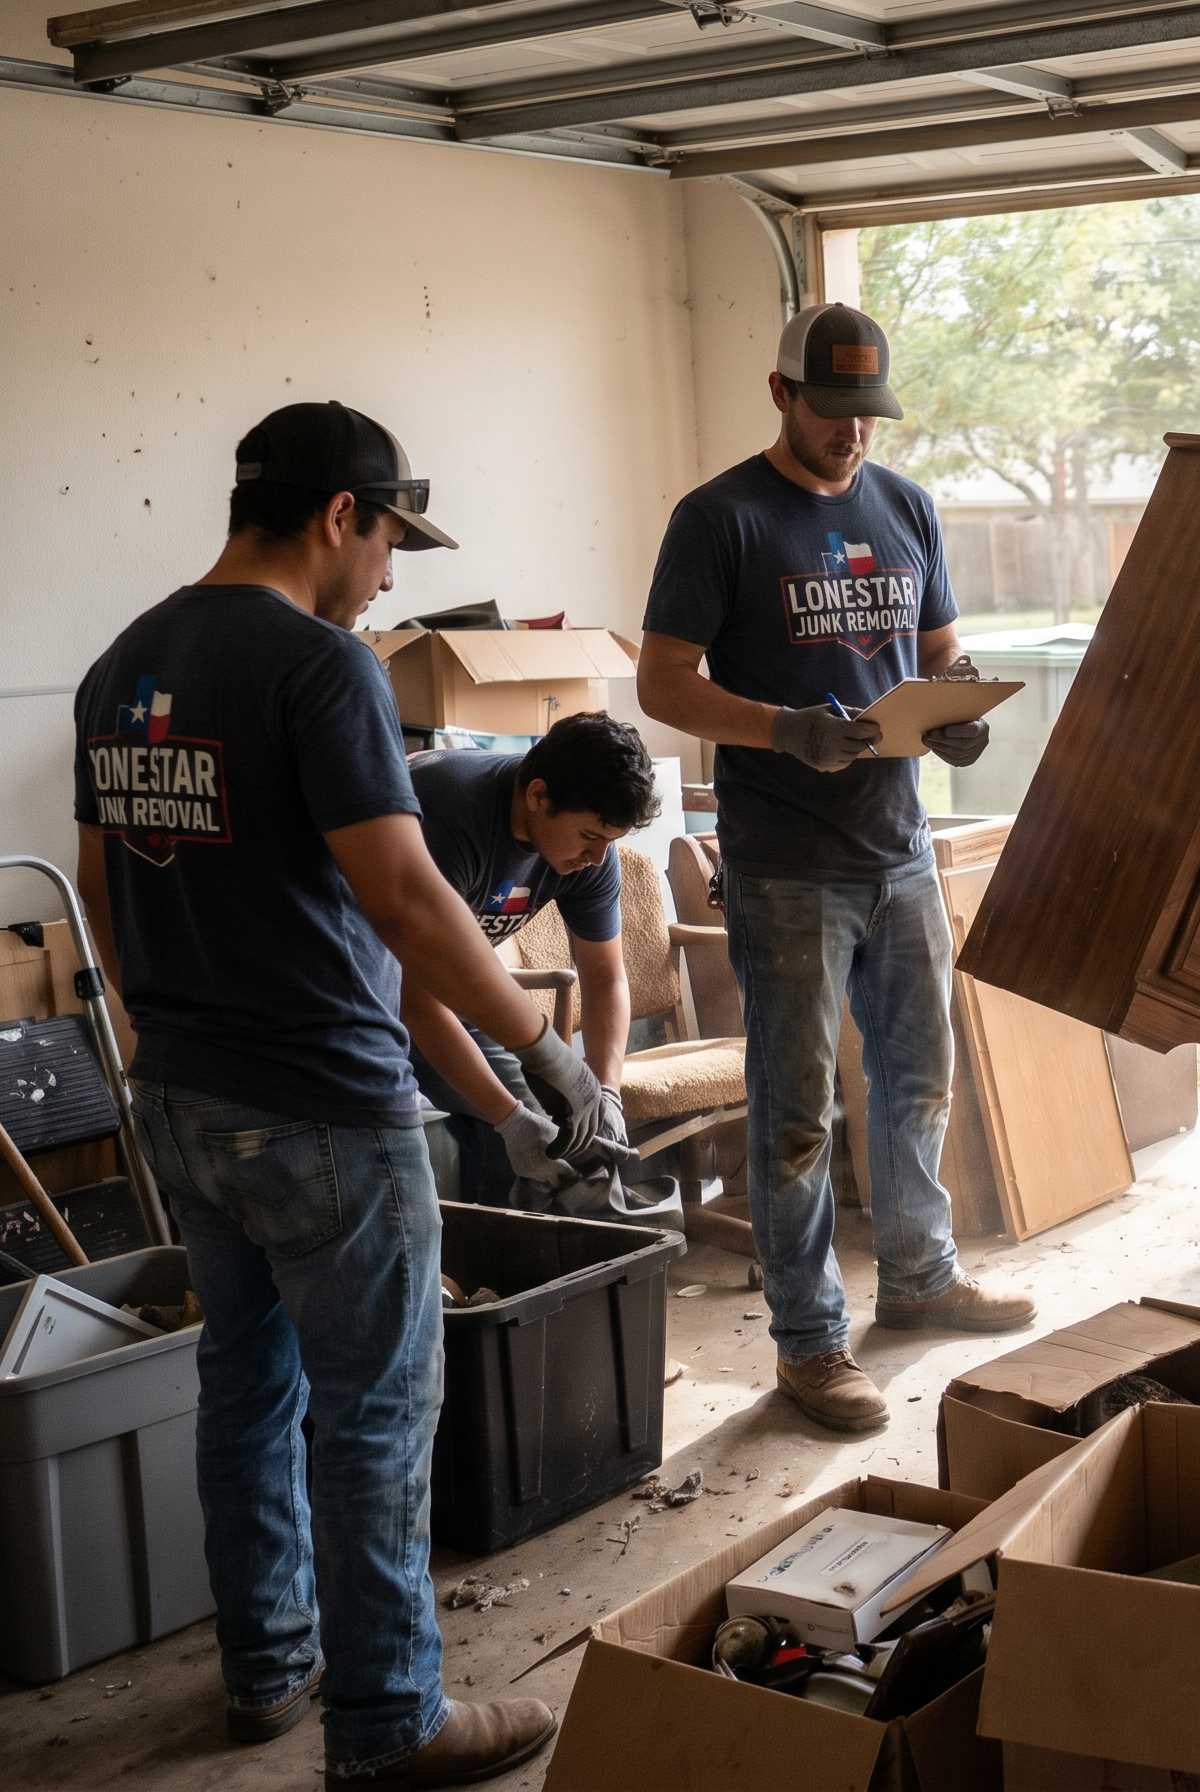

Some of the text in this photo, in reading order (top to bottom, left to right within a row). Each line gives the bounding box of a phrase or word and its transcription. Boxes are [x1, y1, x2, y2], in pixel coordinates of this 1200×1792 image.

[788, 577, 915, 613] LONESTAR
[796, 609, 914, 636] JUNK REMOVAL
[99, 797, 128, 825] UNK
